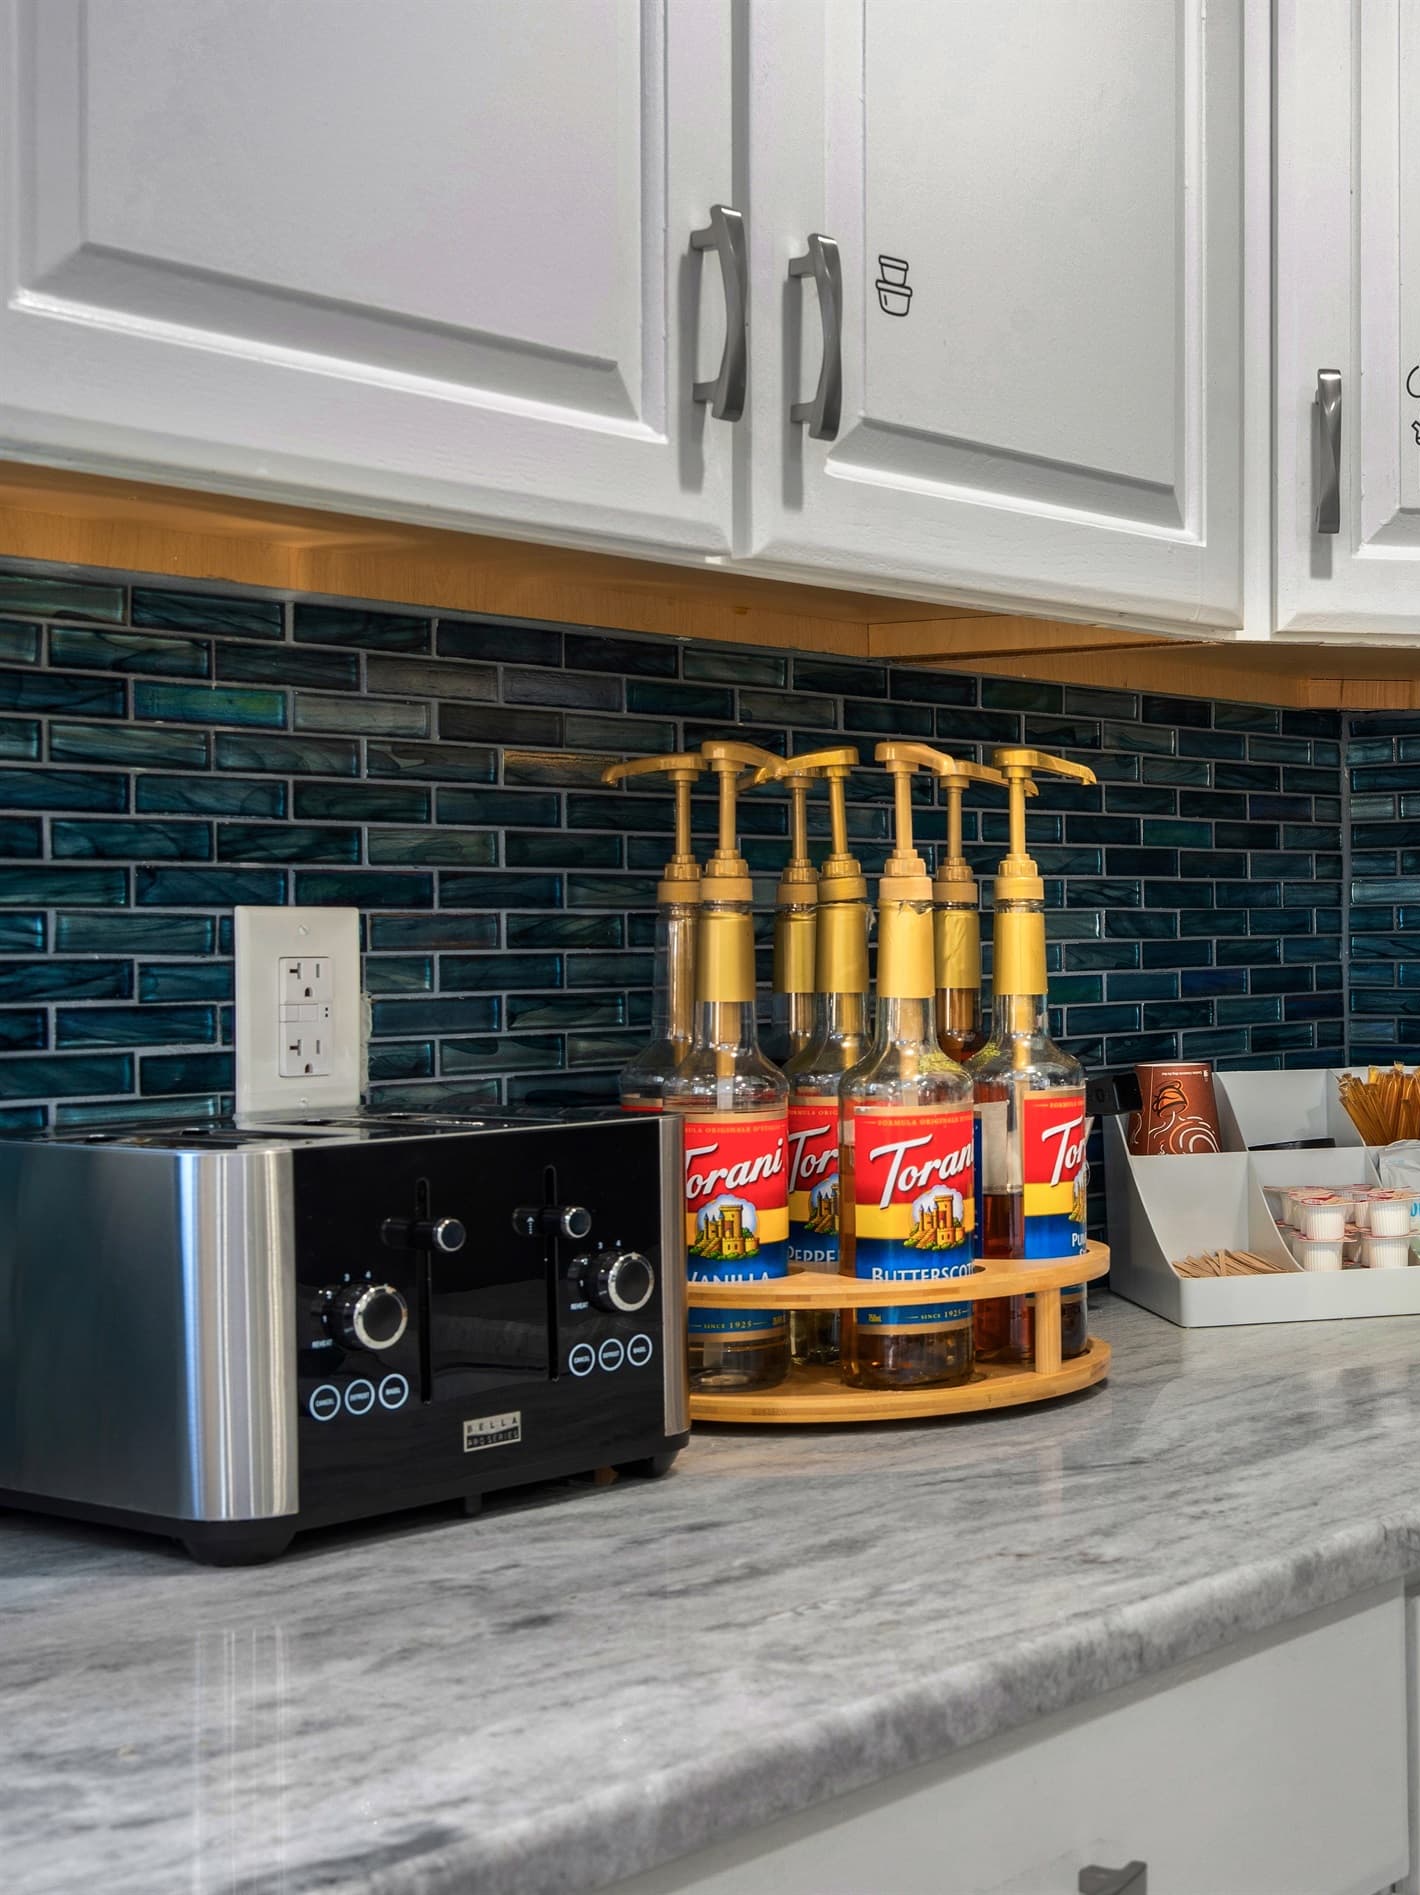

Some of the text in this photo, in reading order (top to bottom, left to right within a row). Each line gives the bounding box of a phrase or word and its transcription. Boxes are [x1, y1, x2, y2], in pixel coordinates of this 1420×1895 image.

[788, 1124, 840, 1193] Tor
[1041, 1115, 1086, 1187] Tor
[869, 1133, 973, 1210] Toran
[788, 1245, 836, 1262] PEPPE
[871, 1262, 975, 1281] BUTTERSCOT
[944, 1309, 961, 1318] 1925
[729, 1320, 753, 1329] 1925
[467, 1416, 518, 1434] BELLA
